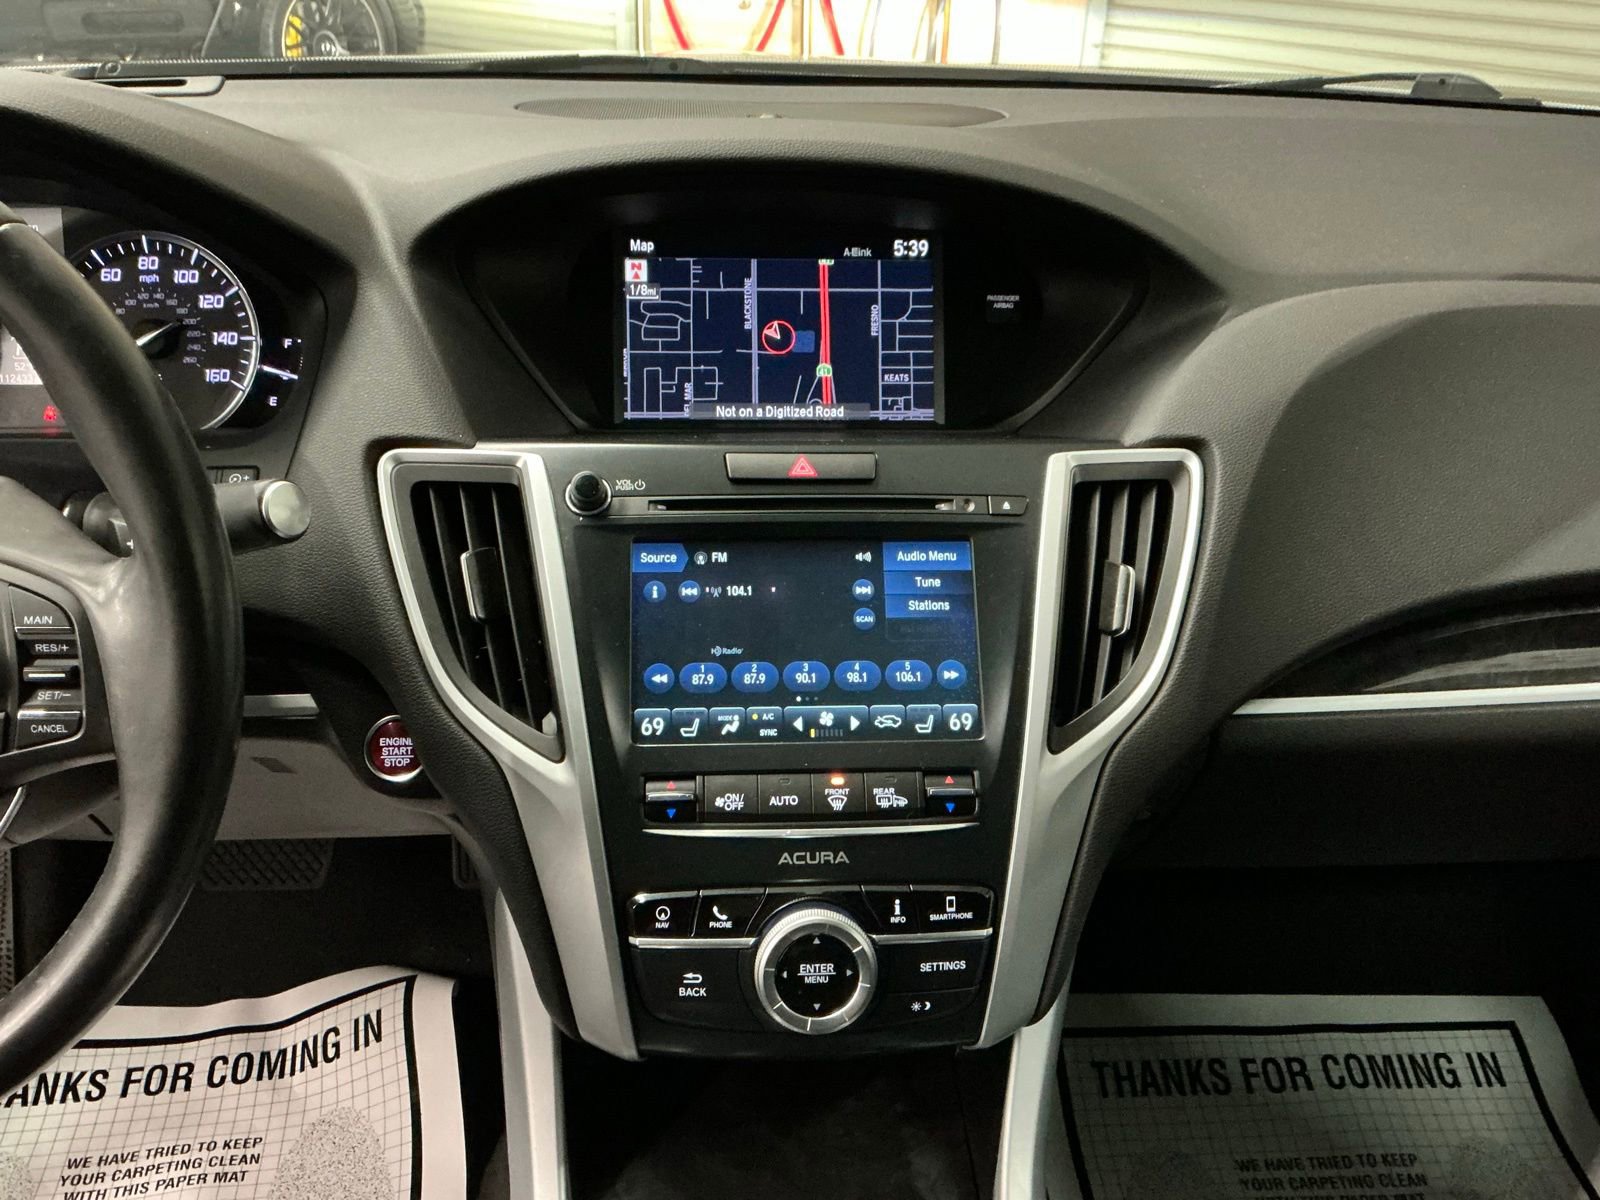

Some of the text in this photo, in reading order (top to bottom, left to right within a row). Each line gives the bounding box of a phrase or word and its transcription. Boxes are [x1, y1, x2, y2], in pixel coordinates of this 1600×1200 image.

[630, 239, 654, 253] Map
[893, 239, 929, 257] 5:39
[138, 256, 158, 270] 80
[631, 262, 642, 271] N
[100, 268, 121, 282] 60
[139, 274, 160, 284] mph
[173, 270, 199, 284] 100
[198, 294, 224, 309] 120
[744, 277, 752, 330] BLACKSTONE
[871, 304, 879, 336] FRESNO
[212, 331, 238, 345] 140
[284, 338, 293, 349] F
[205, 369, 231, 383] 160
[884, 373, 909, 382] KEATS
[269, 396, 278, 407] E
[716, 405, 844, 419] Not on a Digitized Road
[640, 553, 677, 563] Source
[711, 552, 728, 563] FM
[897, 551, 957, 561] Audio Menu
[915, 577, 941, 587] Tune
[726, 586, 753, 596] 104.1
[908, 600, 950, 611] Stations
[23, 616, 53, 624] MAIN
[855, 615, 874, 623] SCAN
[35, 643, 69, 652] RES/+
[700, 664, 705, 672] 1
[803, 663, 809, 671] 3
[854, 663, 860, 671] 4
[905, 662, 910, 670] 5
[691, 674, 714, 684] 87.9
[744, 673, 766, 684] 87.9
[795, 673, 816, 683] 90.1
[847, 672, 867, 683] 98.1
[896, 672, 921, 682] 106.1
[641, 717, 664, 736] 69
[949, 713, 972, 731] 69
[30, 724, 68, 733] CANCEL
[382, 747, 413, 755] START
[384, 758, 410, 767] STOP
[873, 787, 895, 795] REAR
[725, 793, 744, 802] ON/
[769, 796, 799, 806] AUTO
[724, 802, 744, 811] OFF
[778, 851, 850, 865] ACURA
[890, 916, 906, 924] INFO
[929, 912, 973, 921] SMARTPHONE
[799, 963, 834, 973] ENTER
[920, 961, 966, 972] SETTINGS
[679, 987, 707, 997] BACK
[120, 1062, 195, 1098] FOR
[206, 1027, 341, 1088] COMING
[353, 1009, 383, 1052] IN
[1091, 1051, 1508, 1099] THANKS FOR COMING IN
[67, 1137, 263, 1170] WE HAVE TRIED TO KEEP
[1236, 1152, 1418, 1173] WE HAVE TRIED TO KEEP
[59, 1153, 261, 1187] YOUR CARPETING CLEAN
[113, 1182, 150, 1199] THIS
[155, 1173, 208, 1191] PAPER
[213, 1170, 249, 1184] MAT
[1240, 1172, 1428, 1191] YOUR CARPETING CLEAN
